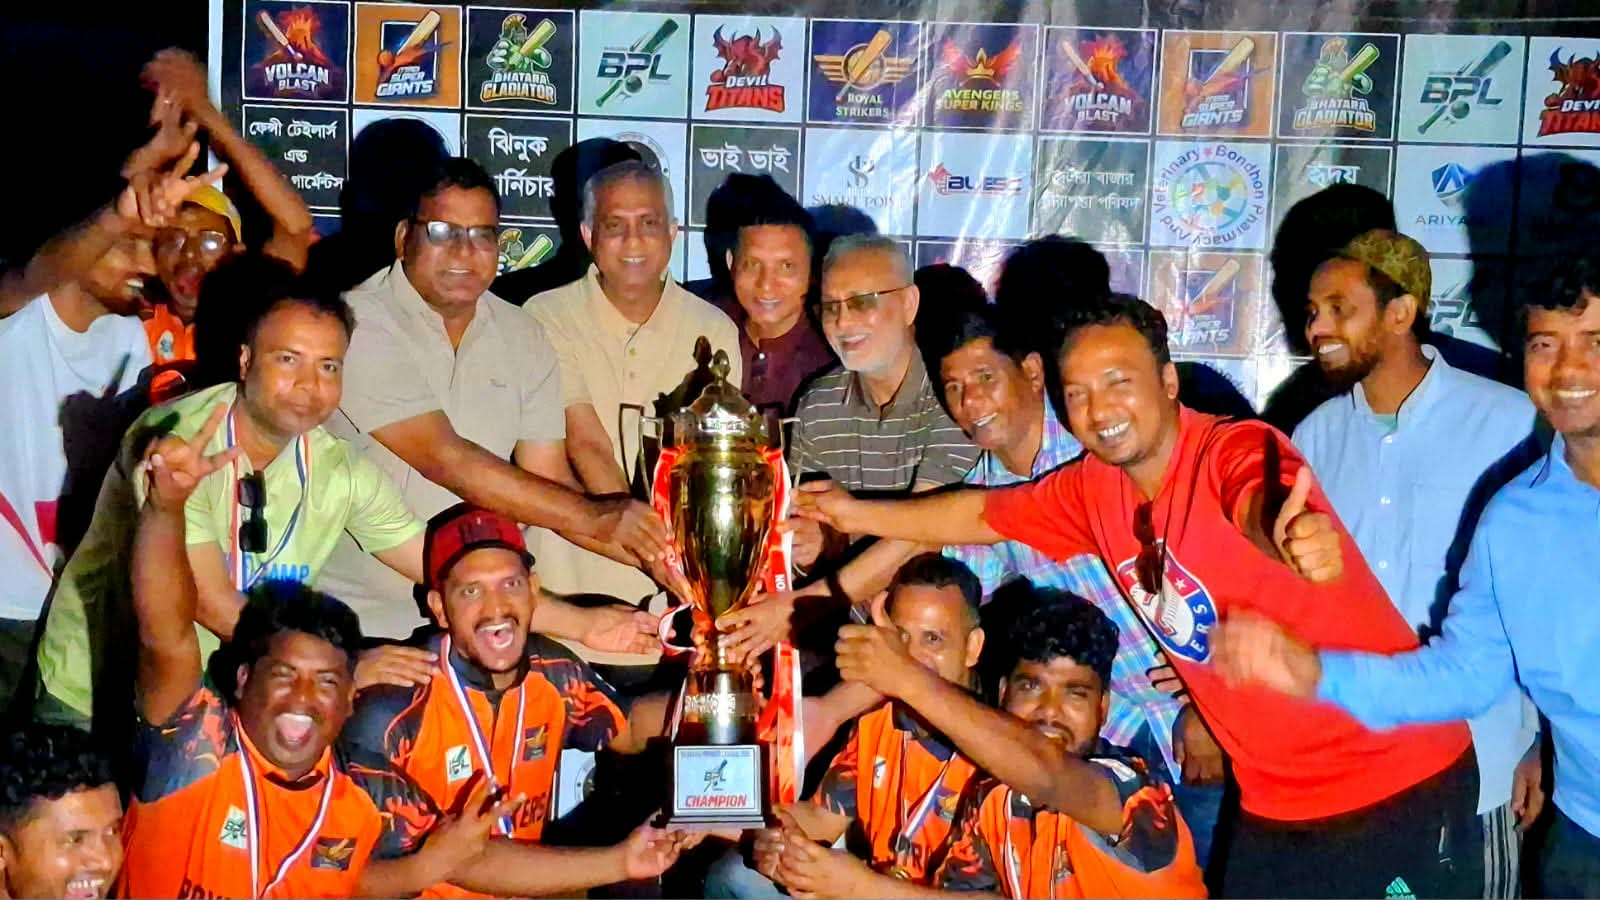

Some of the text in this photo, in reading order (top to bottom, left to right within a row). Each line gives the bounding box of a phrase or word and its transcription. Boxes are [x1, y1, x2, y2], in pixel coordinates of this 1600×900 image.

[265, 63, 329, 85] VOLCAN
[597, 52, 672, 80] BPL
[278, 79, 317, 93] BLAST
[493, 71, 547, 84] BHATARA
[725, 75, 767, 88] DEVIL
[376, 80, 433, 97] GIANTS
[483, 82, 554, 102] GLADIATOR
[943, 89, 1020, 101] AVENGERS
[1420, 76, 1503, 105] BPL
[705, 84, 785, 113] TITANS
[847, 93, 883, 105] ROYAL
[936, 99, 1024, 112] SUPER KINGS
[1063, 93, 1132, 115] VOLCAN
[1561, 99, 1600, 112] DEVI
[835, 106, 889, 118] STRIKERS
[1077, 110, 1119, 122] BLAST
[1181, 110, 1243, 128] GIANTS
[1295, 110, 1375, 130] GLADIATOR
[488, 127, 549, 163] ঝিনুক
[699, 141, 742, 172] ভাই
[747, 143, 792, 173] ভাই
[1215, 144, 1264, 199] Bondhon
[493, 167, 555, 199] ার্নিচার
[1415, 215, 1467, 225] ARIYA
[685, 794, 747, 808] CHAMPION
